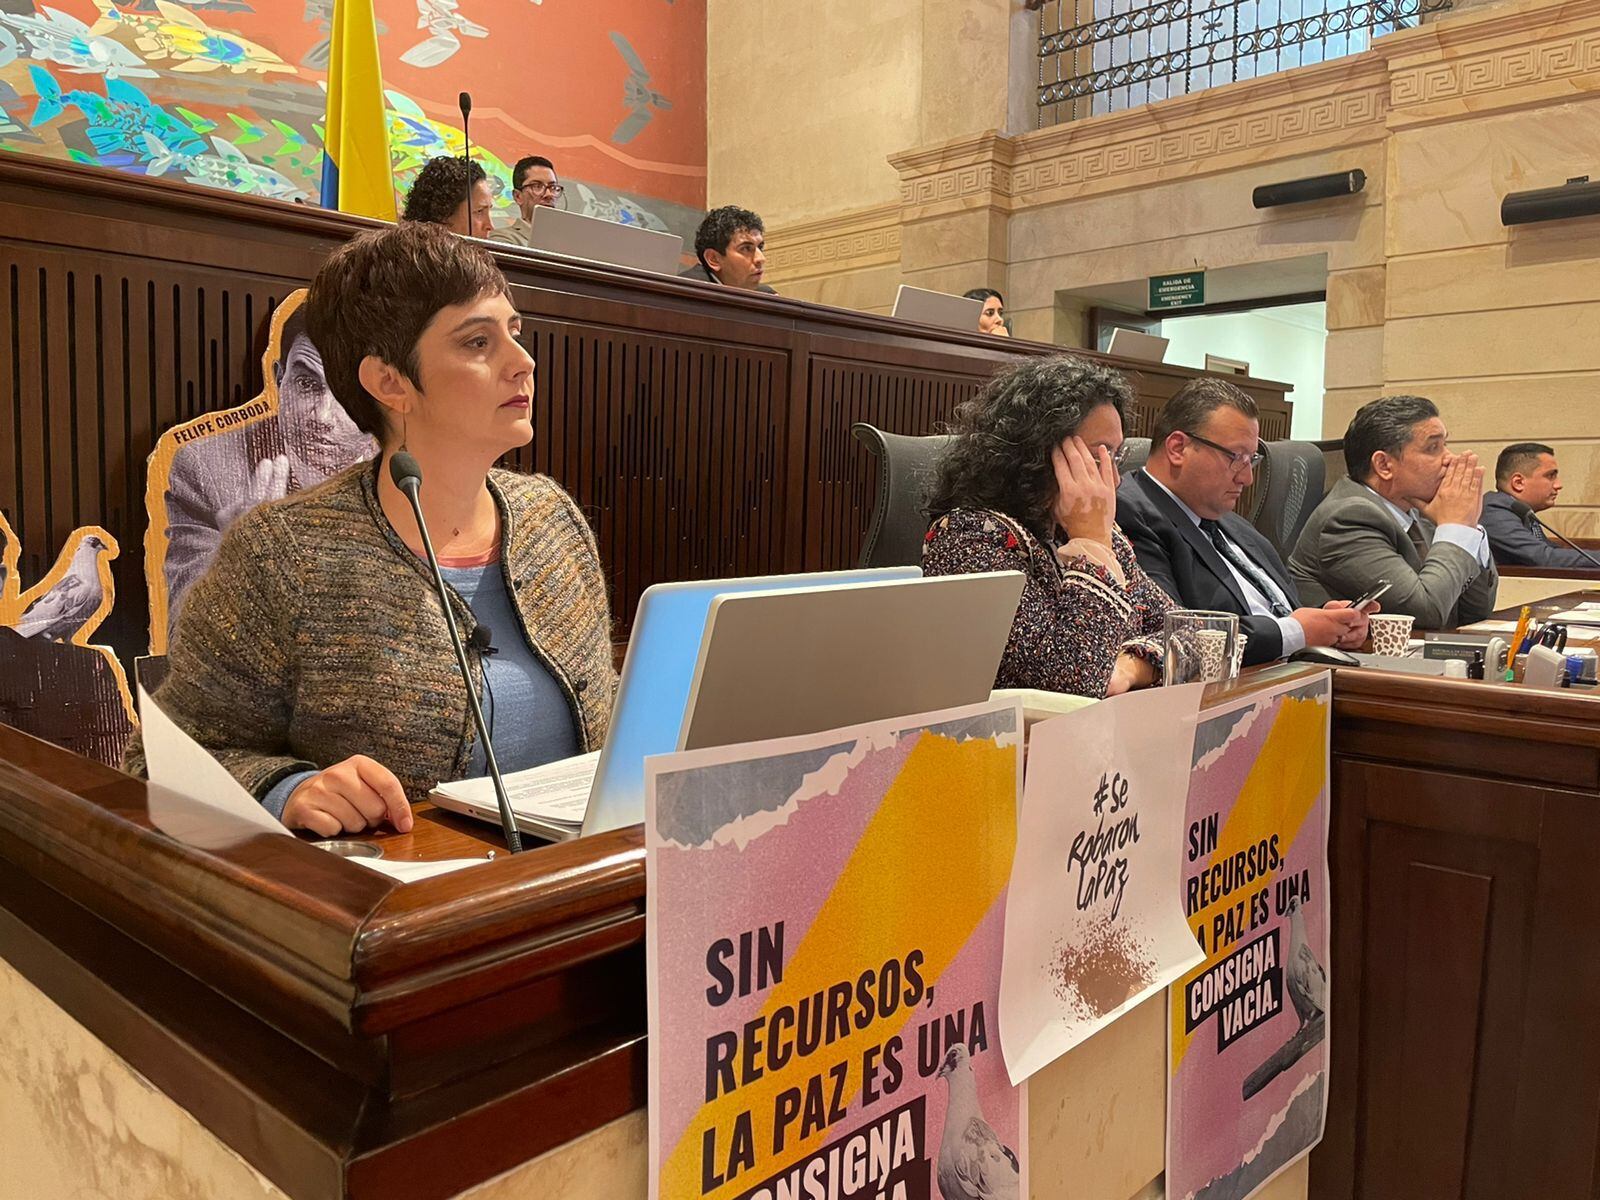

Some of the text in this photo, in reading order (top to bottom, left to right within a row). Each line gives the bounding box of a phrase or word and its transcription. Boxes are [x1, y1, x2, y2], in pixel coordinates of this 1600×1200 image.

[1159, 284, 1195, 292] EMERGENCIA
[173, 401, 271, 444] FELIPE CORBODA
[1067, 812, 1141, 873] Robaron
[1187, 833, 1284, 918] RECURSOS,
[1188, 812, 1219, 862] SIN
[1197, 869, 1311, 955] A PAZ ES UNA
[706, 920, 785, 1007] SIN
[1191, 935, 1276, 1021] CONSIGNA
[705, 949, 934, 1104] RECURSOS,
[1222, 974, 1279, 1042] VACÍA.
[702, 1001, 988, 1196] LA PAZ ES UNA
